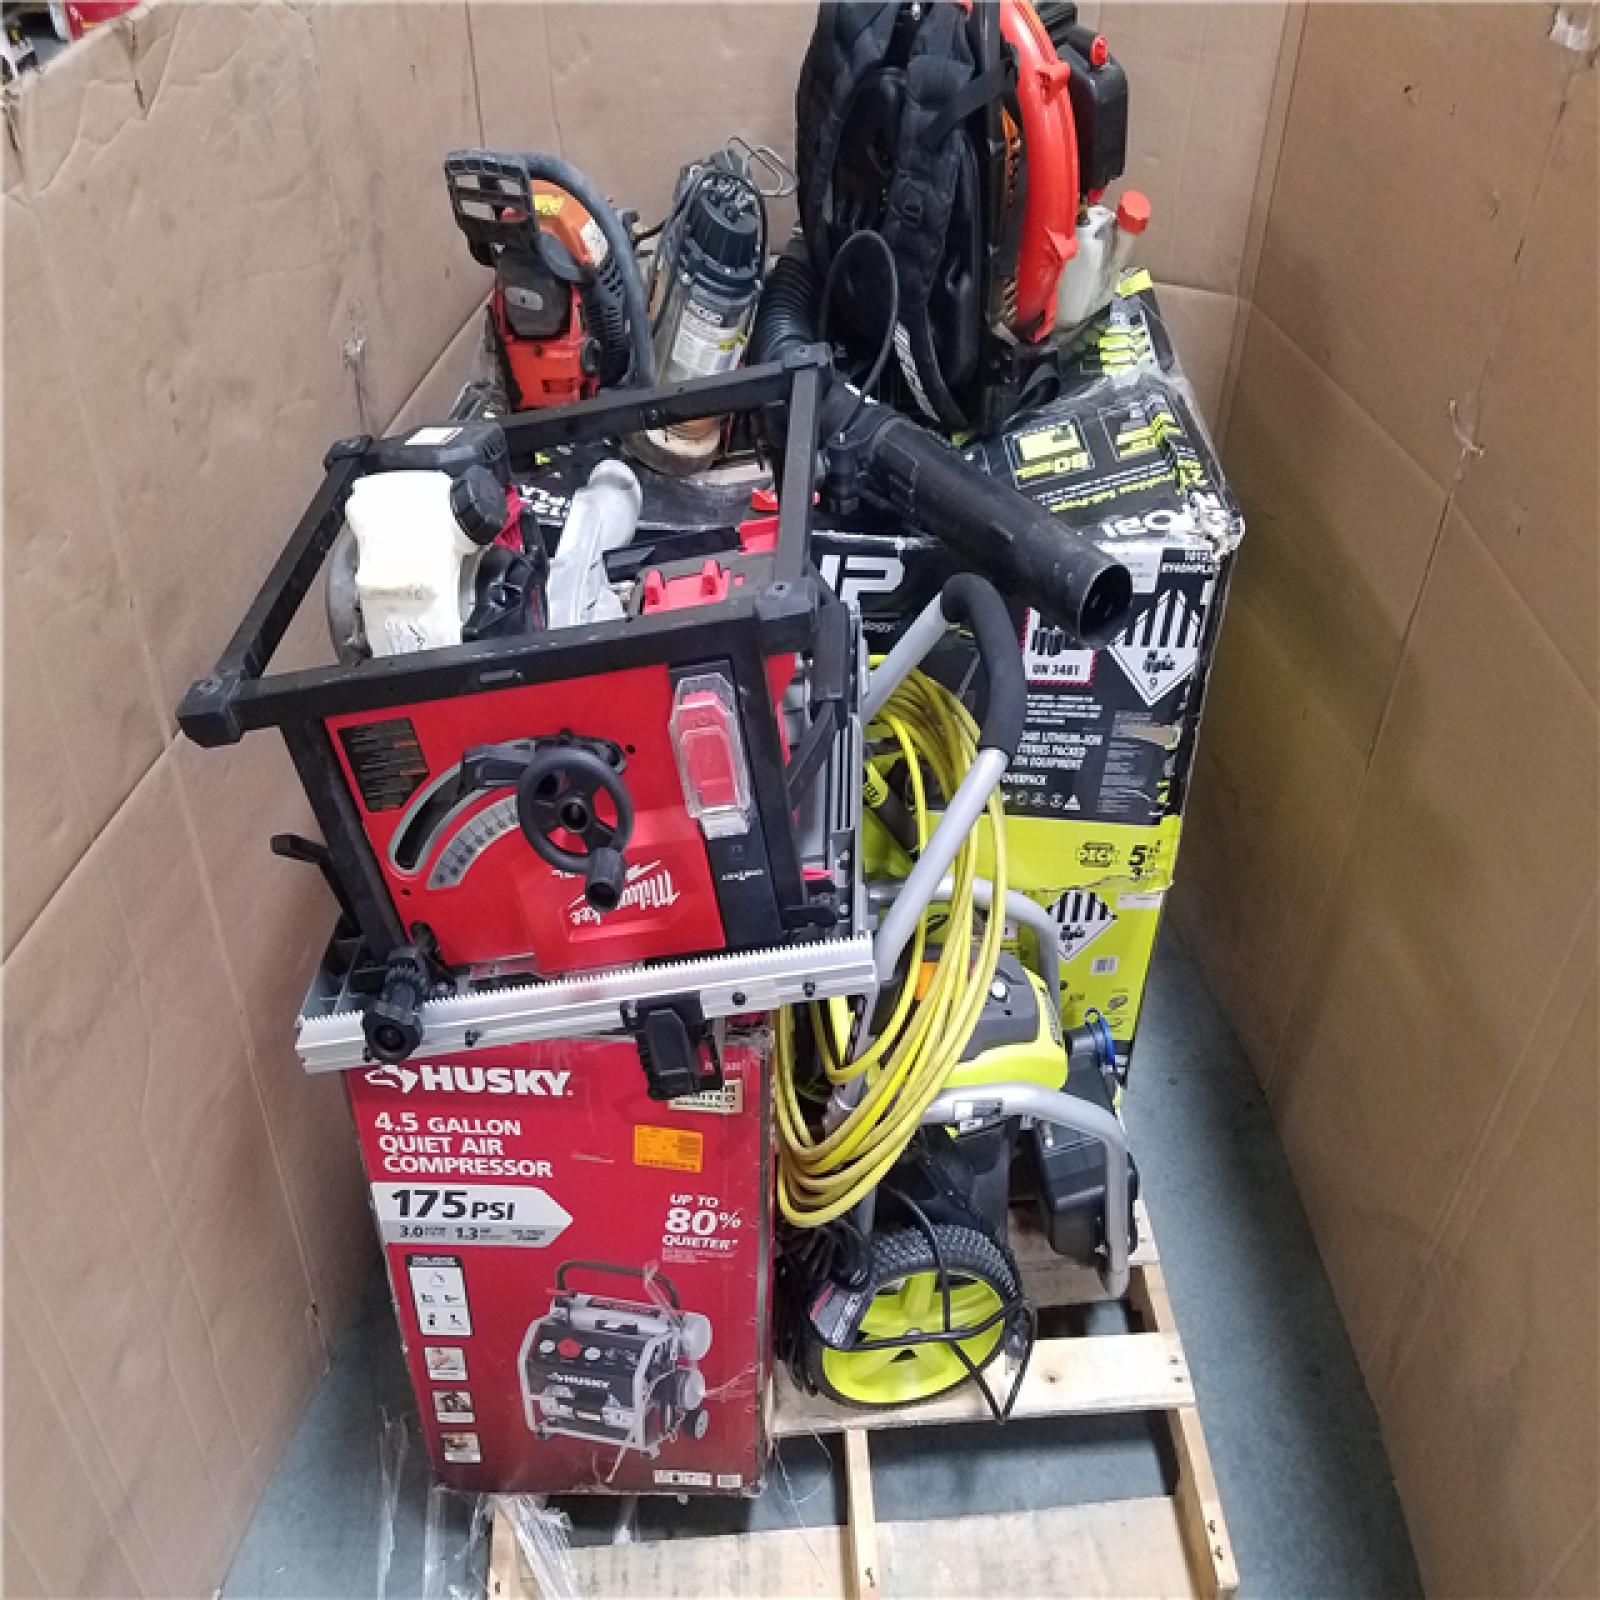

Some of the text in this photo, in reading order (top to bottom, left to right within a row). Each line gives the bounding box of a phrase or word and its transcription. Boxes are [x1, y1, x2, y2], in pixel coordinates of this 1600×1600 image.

[1032, 664, 1048, 676] UN
[422, 1064, 571, 1096] HUSKY
[374, 1111, 521, 1136] 4.5 GALLON
[379, 1133, 503, 1156] QUIET AIR
[383, 1155, 553, 1179] COMPRESSOR
[391, 1188, 516, 1221] 175 PSI
[670, 1193, 719, 1208] UP TO
[399, 1224, 423, 1239] 3.0
[665, 1206, 741, 1236] 80%
[456, 1226, 478, 1240] 1.3
